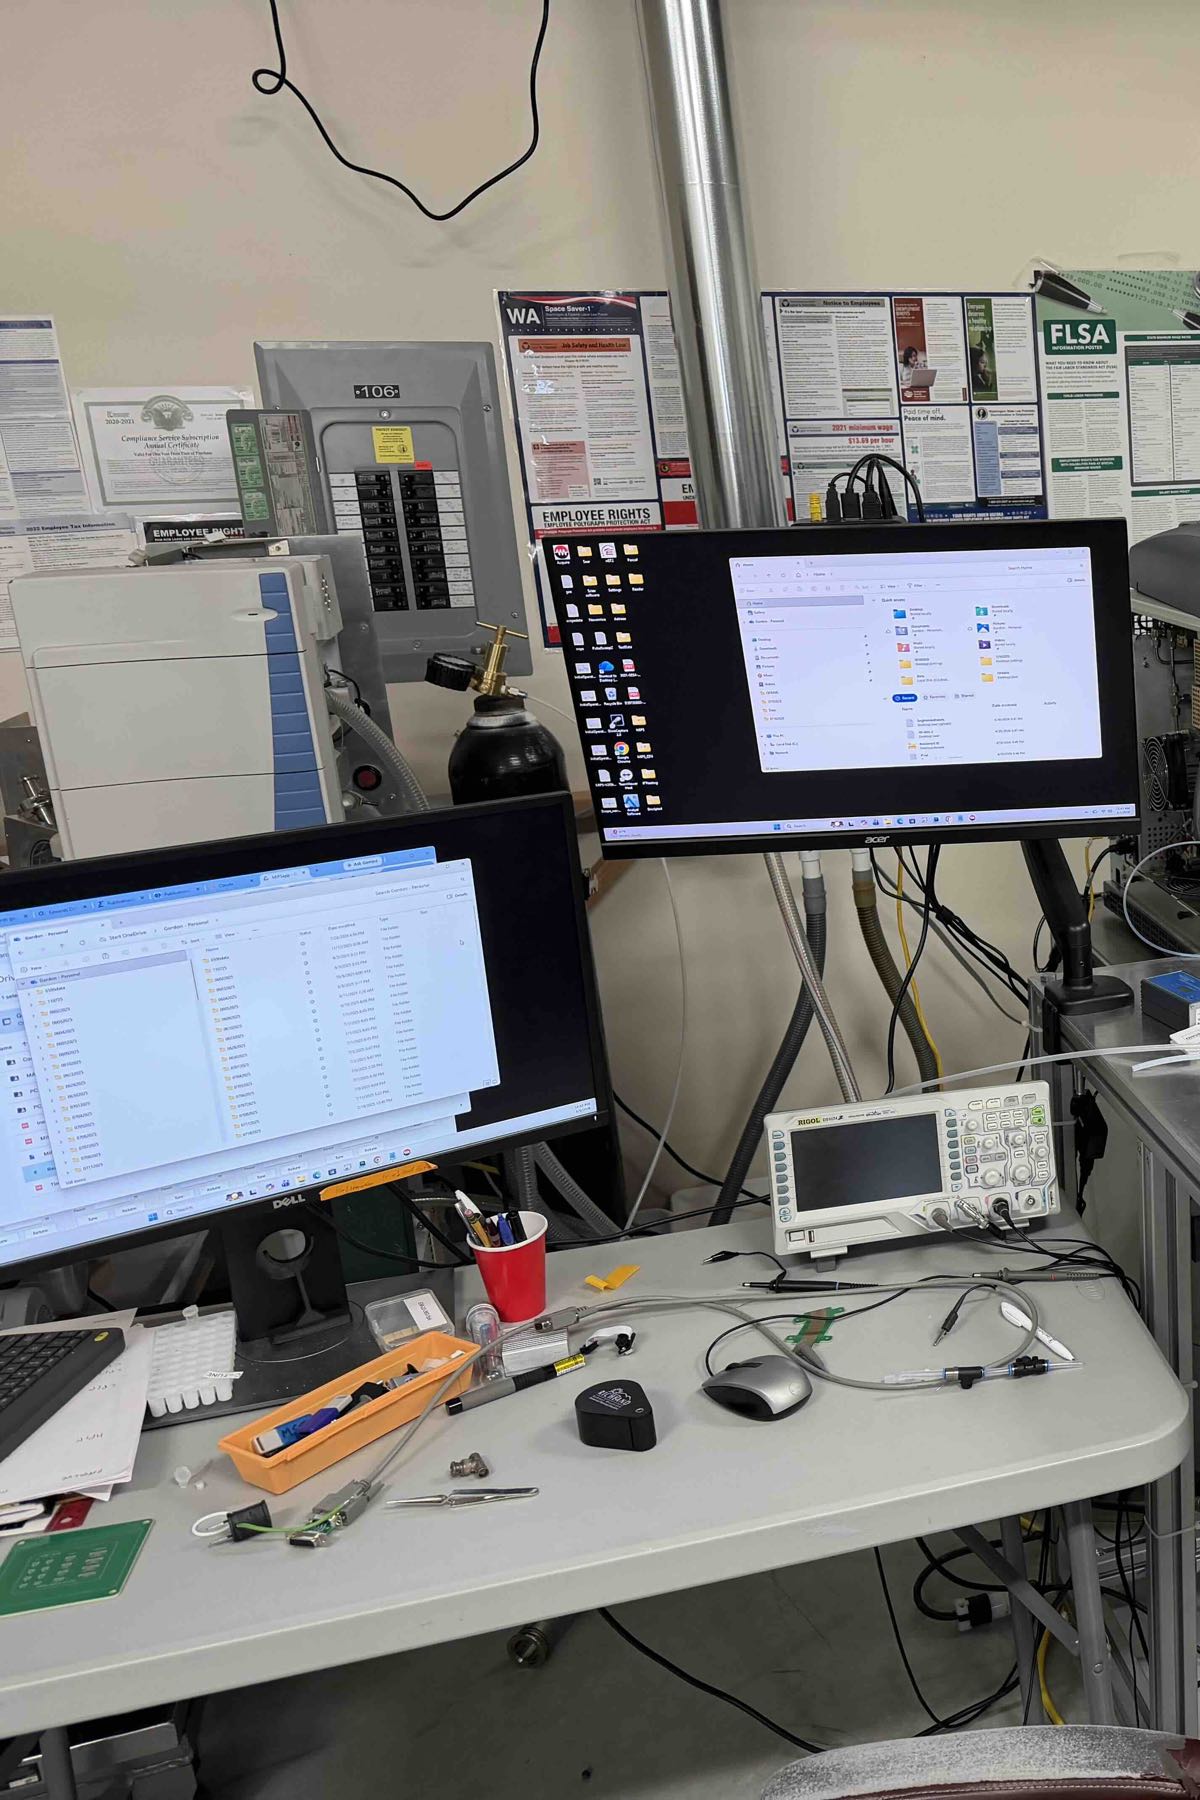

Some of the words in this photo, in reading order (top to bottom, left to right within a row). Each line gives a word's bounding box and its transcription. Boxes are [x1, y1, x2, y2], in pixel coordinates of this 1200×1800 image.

[544, 305, 566, 313] Space
[506, 308, 541, 325] WA
[1050, 323, 1110, 345] FLSA
[360, 385, 395, 398] 106
[877, 424, 894, 432] wage
[121, 435, 157, 443] Compliance
[181, 433, 220, 441] Subscription
[167, 441, 200, 449] Certificate
[542, 509, 605, 522] EMPLOYEE
[608, 507, 651, 519] RIGHTS
[153, 528, 209, 538] EMPLOYEE
[865, 835, 890, 844] acer
[797, 1117, 821, 1126] RIGOL
[272, 1193, 306, 1209] DELL
